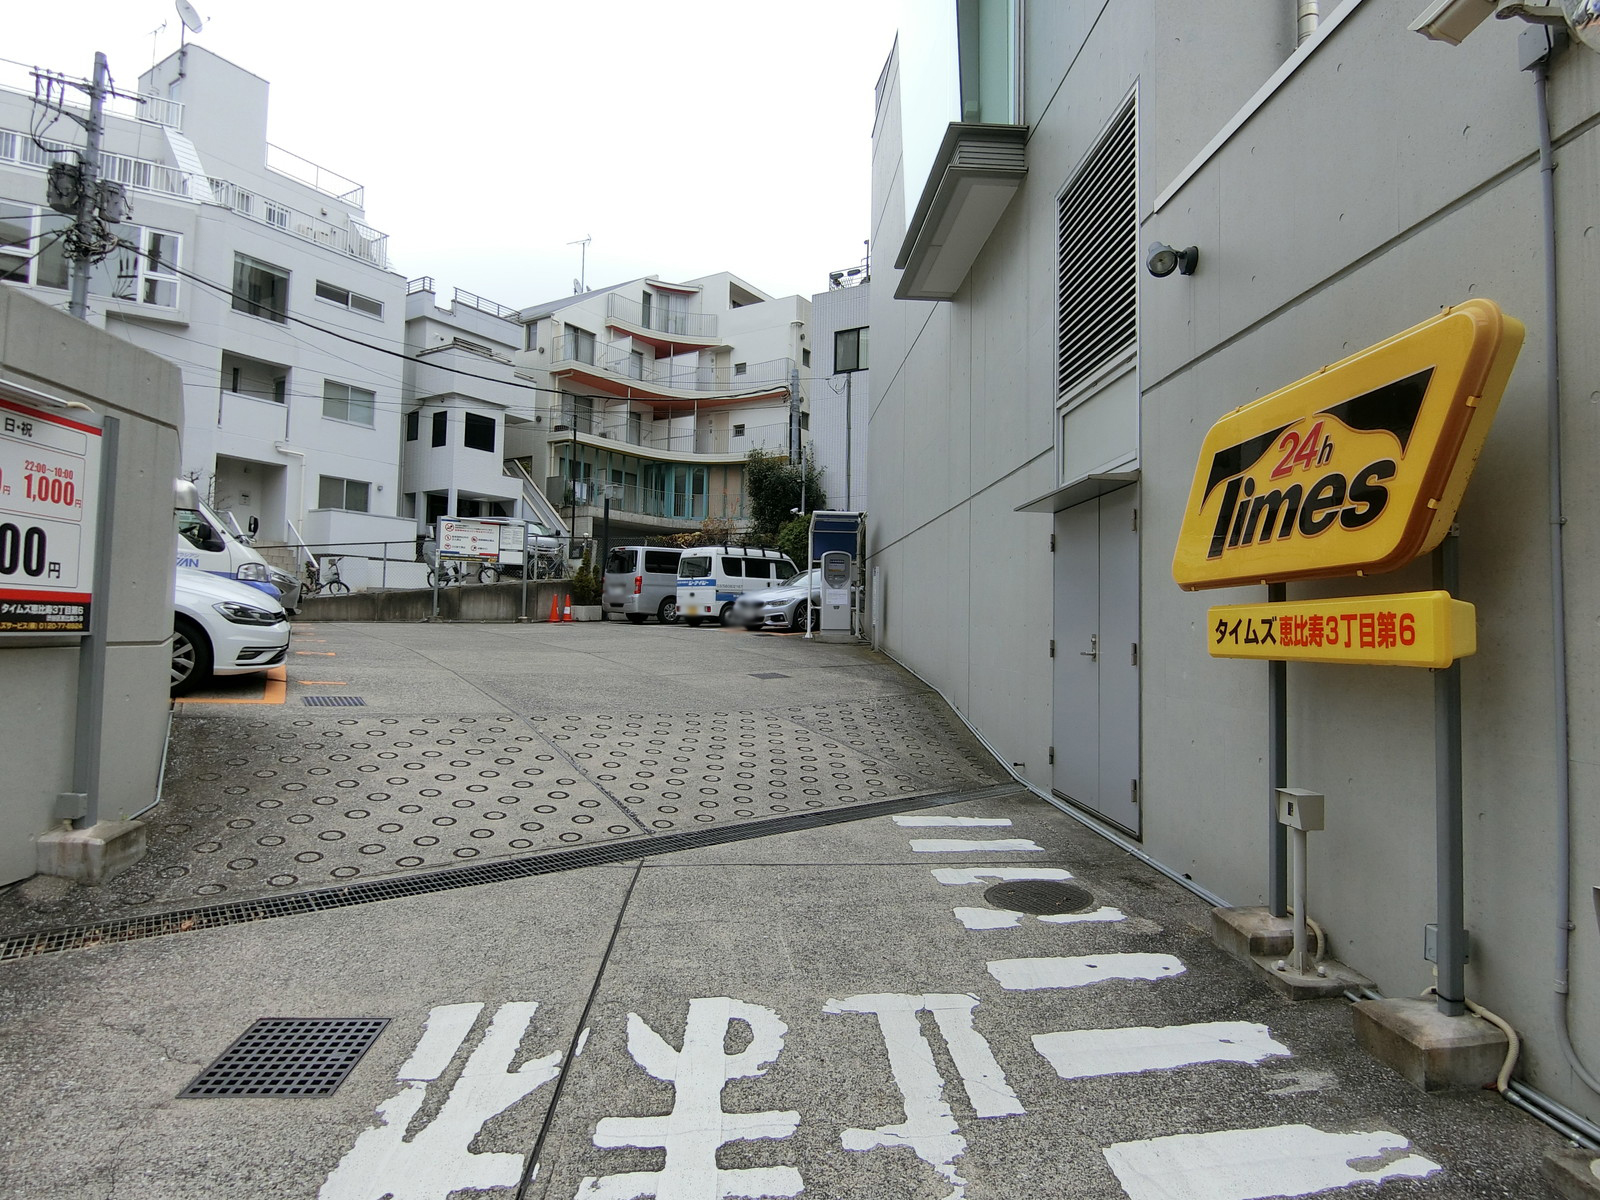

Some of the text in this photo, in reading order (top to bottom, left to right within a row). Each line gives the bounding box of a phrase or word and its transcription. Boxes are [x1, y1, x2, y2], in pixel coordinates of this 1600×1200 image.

[1270, 421, 1334, 480] 24h
[1205, 457, 1397, 560] Times
[1215, 611, 1416, 649] タイムズ恵比寿3丁目第6
